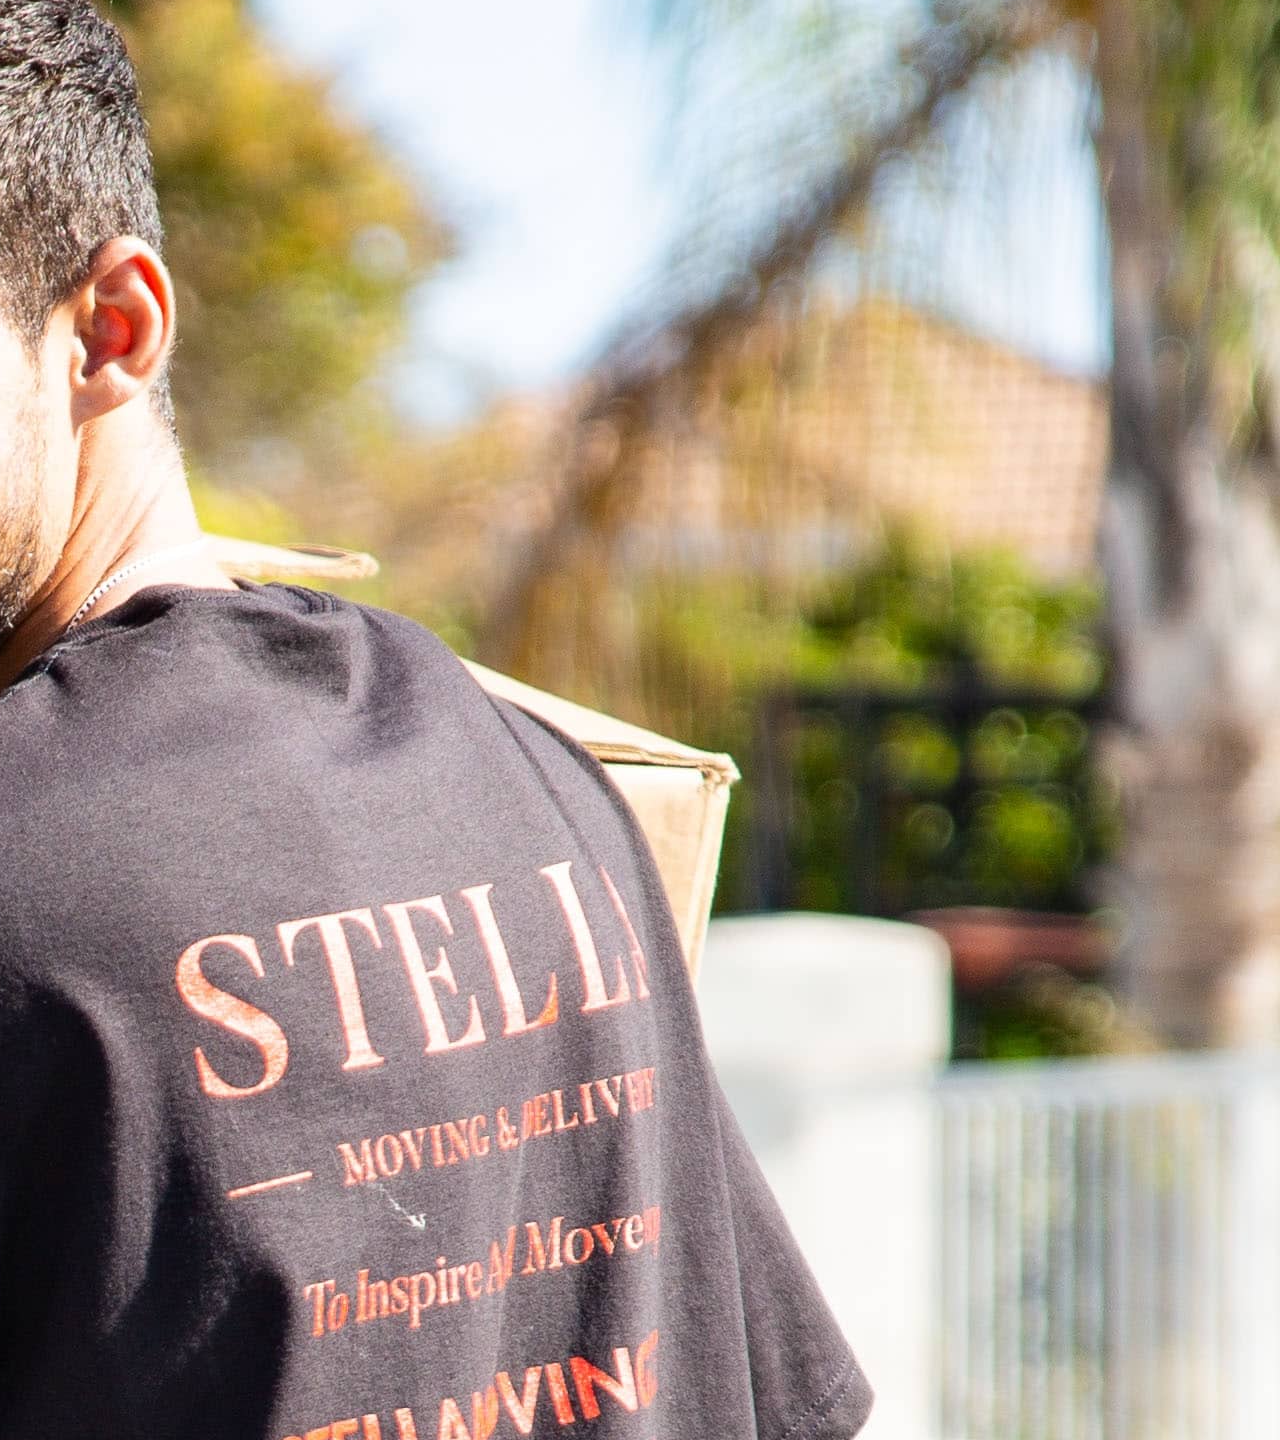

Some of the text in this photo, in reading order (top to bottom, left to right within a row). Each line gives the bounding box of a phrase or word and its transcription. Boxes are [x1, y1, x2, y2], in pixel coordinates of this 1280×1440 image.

[337, 1114, 490, 1187] MOVING
[496, 1106, 520, 1152] &
[303, 1278, 350, 1339] To
[355, 1255, 484, 1330] Inspire
